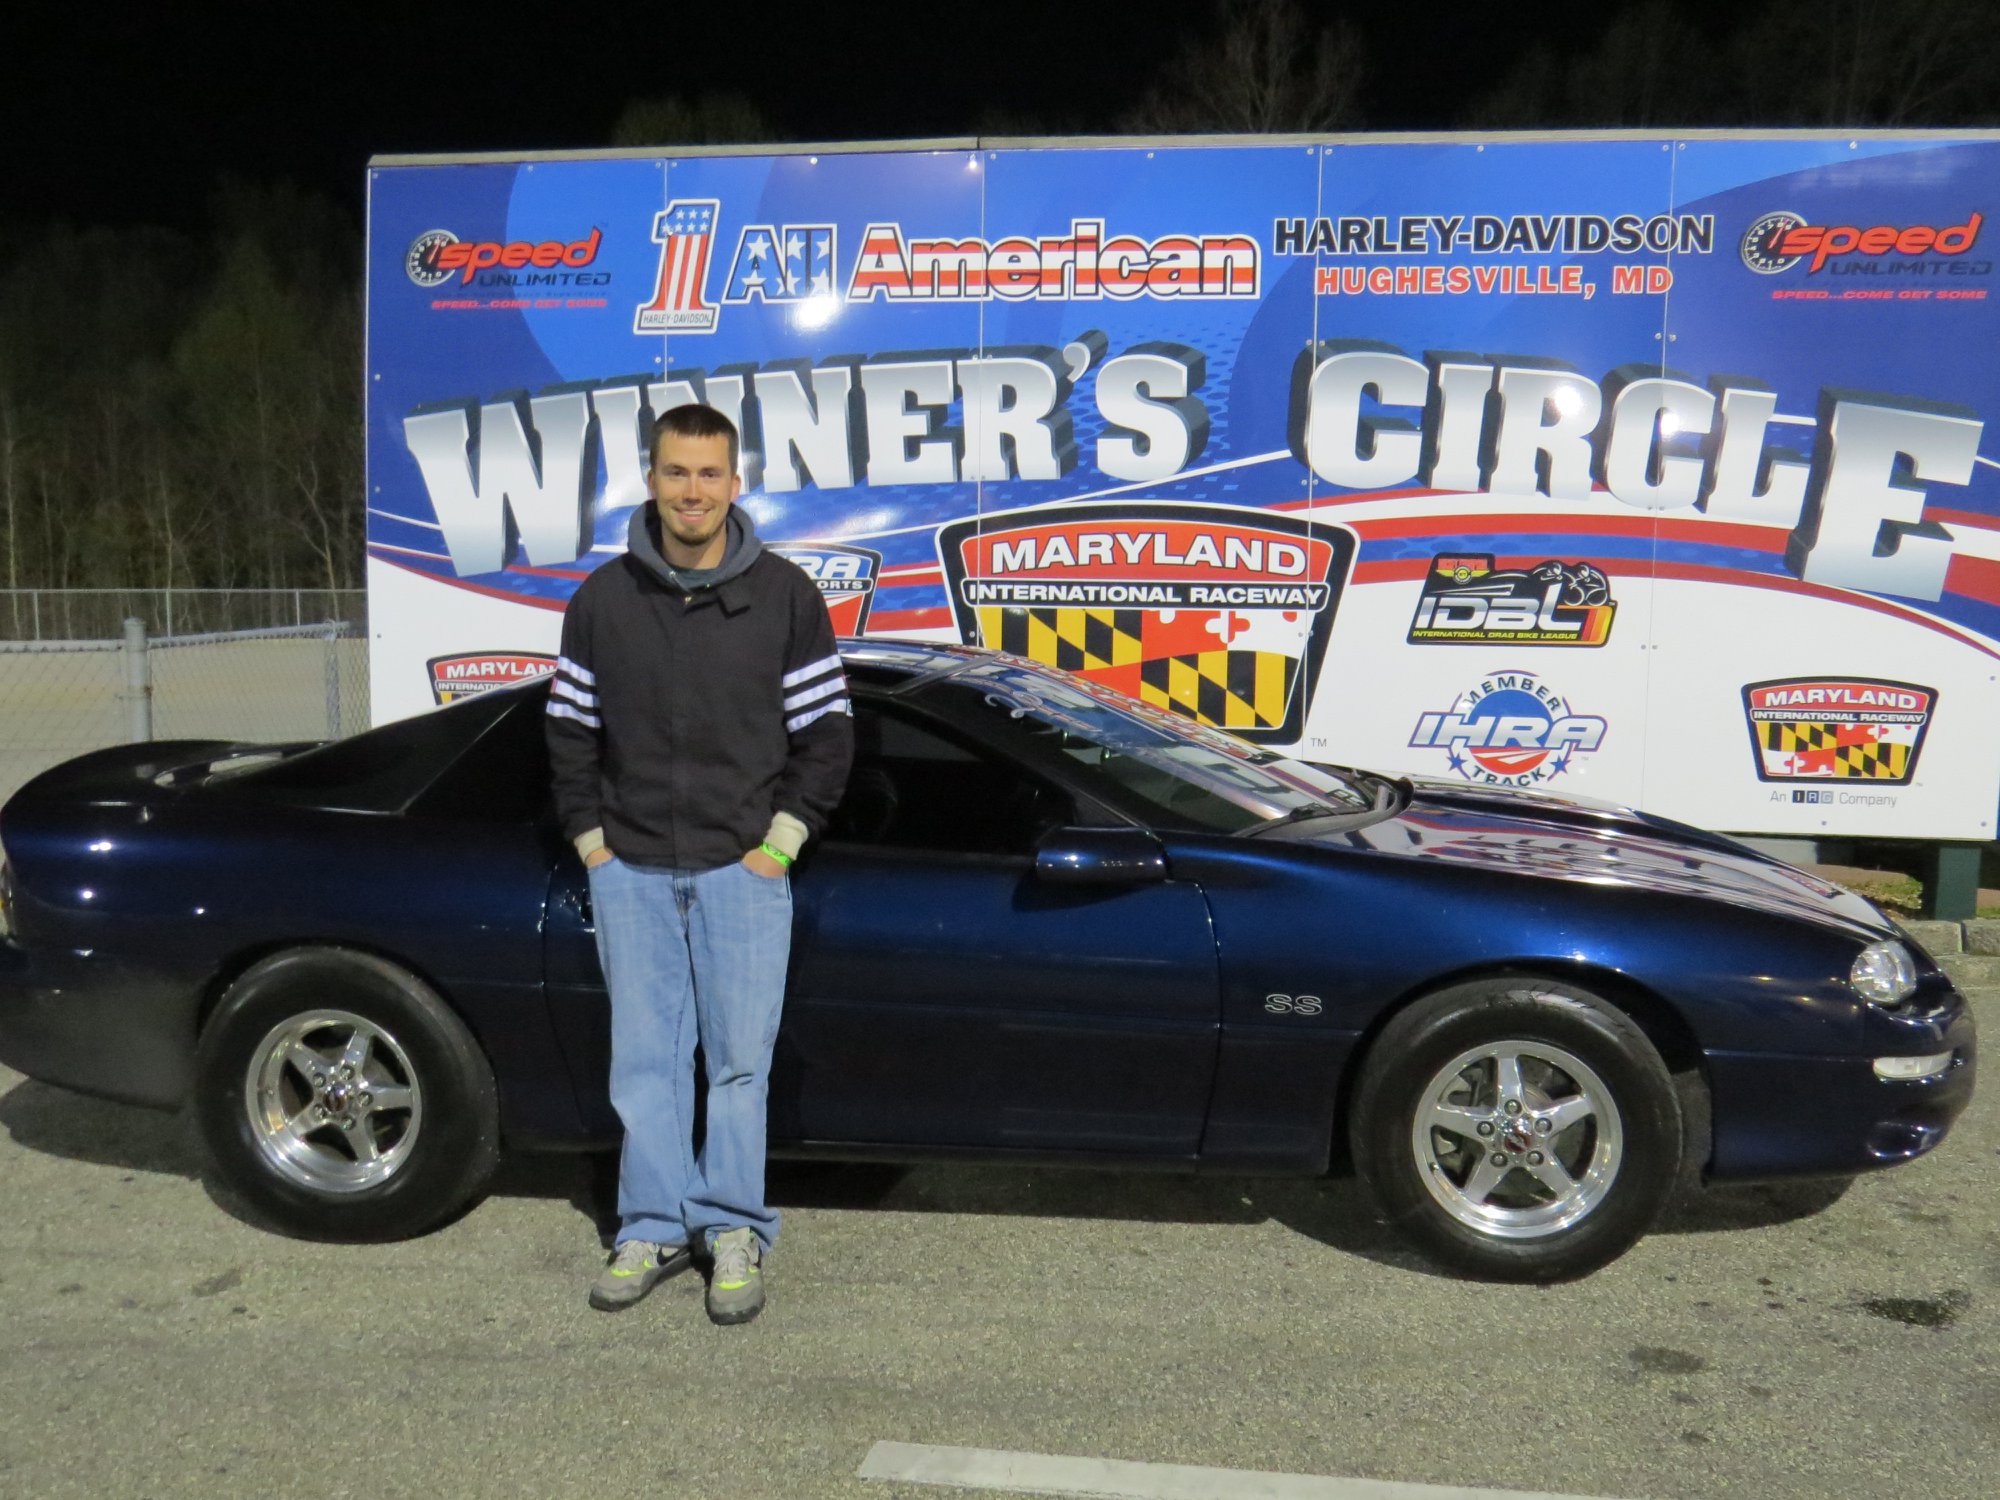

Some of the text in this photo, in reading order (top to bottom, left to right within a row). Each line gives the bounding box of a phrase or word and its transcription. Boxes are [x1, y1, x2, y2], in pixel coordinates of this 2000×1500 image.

[1273, 214, 1716, 256] HARLEY-DAVIDSON
[1780, 211, 1984, 275] speed
[437, 226, 602, 287] speed
[722, 224, 838, 304] All
[845, 218, 1262, 302] American
[479, 272, 612, 287] UNLIMITED
[1831, 261, 1994, 276] UNLIMITED
[1314, 265, 1674, 300] HUGHESVILLE, MD
[1898, 290, 1931, 299] GET
[1936, 290, 1988, 299] SOME
[1294, 342, 1984, 602] CIRCLE
[991, 531, 1310, 578] MARYLAND
[786, 555, 861, 580] RA
[816, 579, 864, 591] ORTS
[969, 583, 1324, 607] INTERNATIONAL RACEWAY
[1415, 582, 1582, 631] IDBL
[1412, 630, 1578, 641] INTERNATIONAL DRAG BIKE LEAGUE
[446, 661, 558, 679] MARYLAN
[438, 682, 501, 691] INTERNATI
[1465, 675, 1562, 712] MEMBER
[1764, 688, 1917, 709] MARYLAND
[1754, 711, 1925, 723] INTERNATIONAL RACEWAY
[1310, 737, 1328, 748] TM
[1409, 712, 1609, 752] IHRA
[1472, 765, 1546, 787] TRACK
[1770, 790, 1787, 803] An
[1838, 792, 1898, 807] Company
[1264, 993, 1323, 1016] SS
